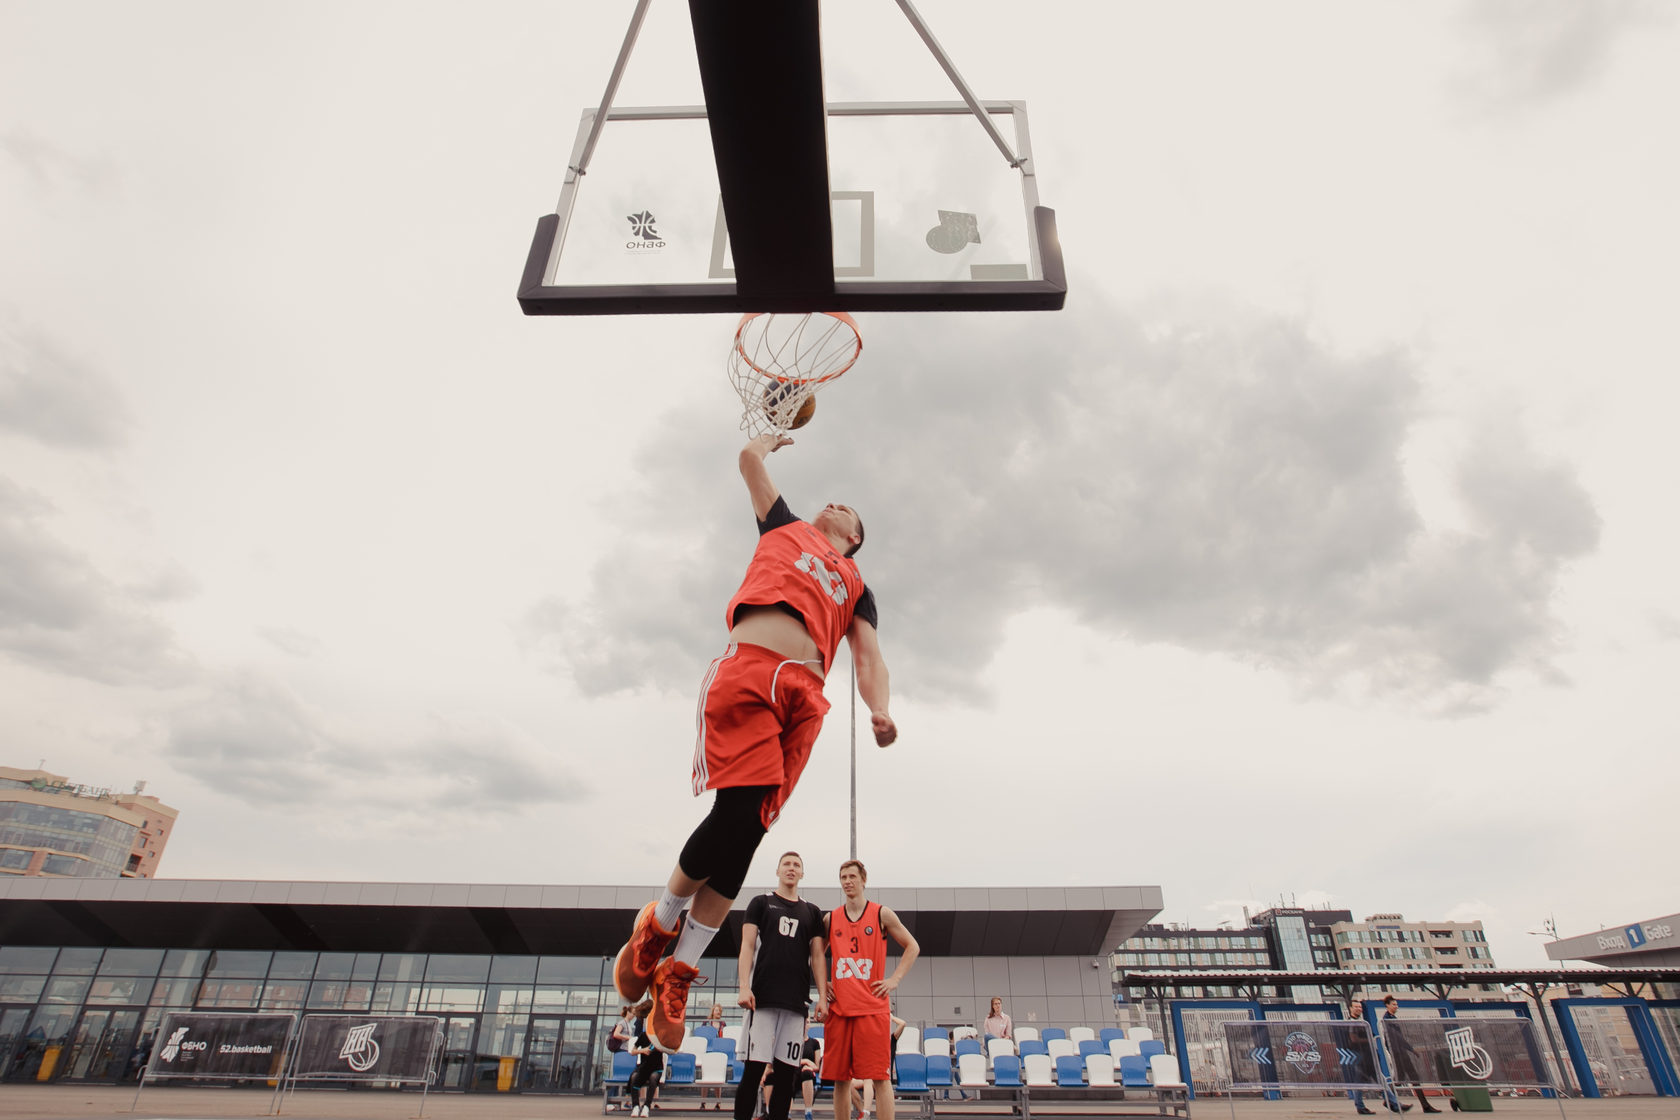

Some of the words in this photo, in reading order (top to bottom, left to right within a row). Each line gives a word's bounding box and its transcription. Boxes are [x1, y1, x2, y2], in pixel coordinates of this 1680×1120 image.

[778, 916, 799, 938] 67
[850, 936, 859, 953] 3
[1596, 935, 1626, 950] Вход
[1629, 928, 1640, 944] 1
[1644, 924, 1674, 940] Gate
[219, 1044, 273, 1054] 52.basketball
[787, 1041, 800, 1060] 10
